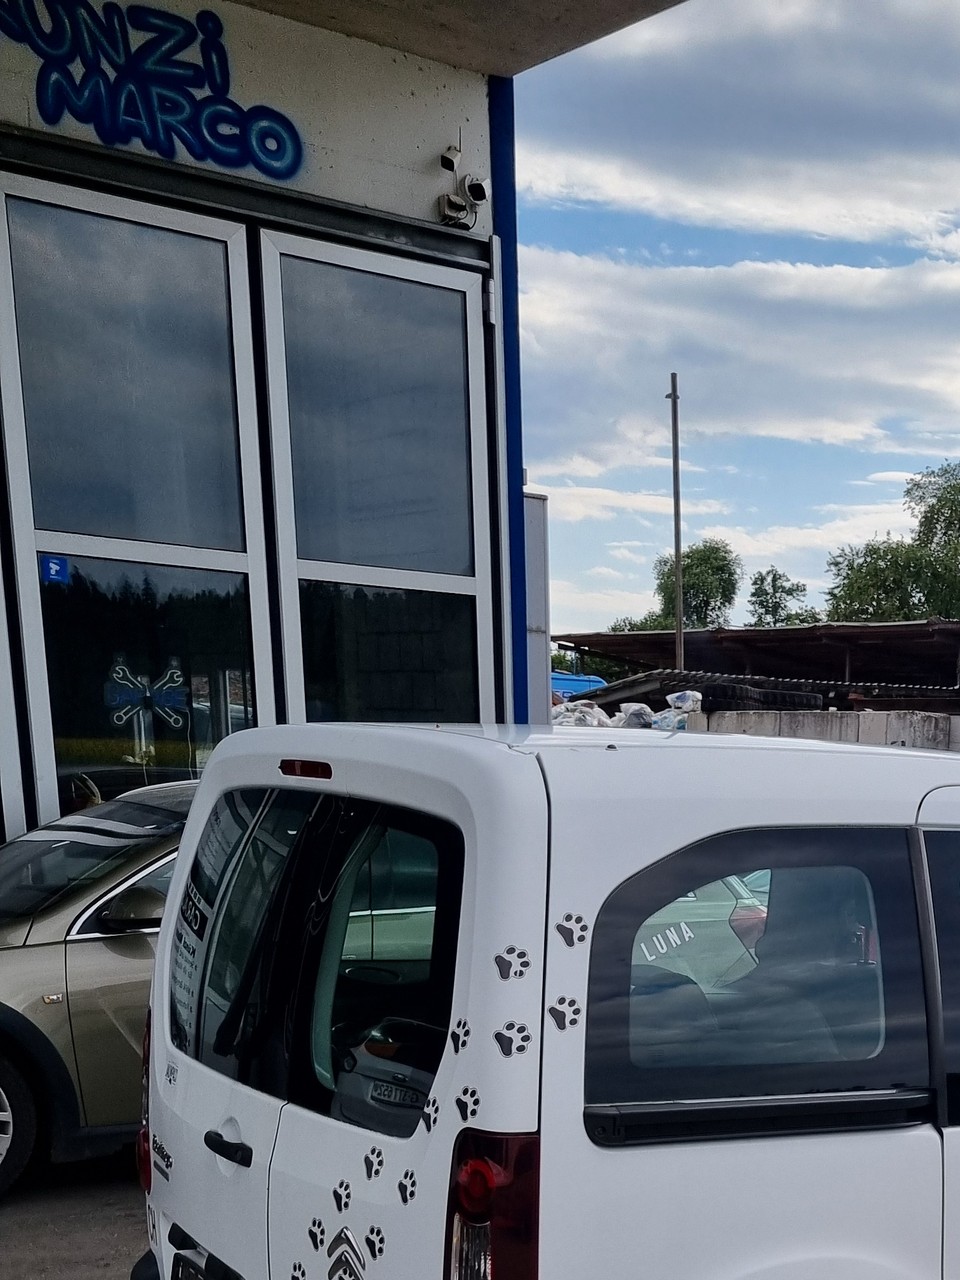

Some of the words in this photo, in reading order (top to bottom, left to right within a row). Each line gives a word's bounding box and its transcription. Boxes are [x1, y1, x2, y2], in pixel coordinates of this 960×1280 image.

[0, 0, 230, 97] UNZi
[36, 61, 303, 180] MARCO
[639, 921, 695, 962] LUNA
